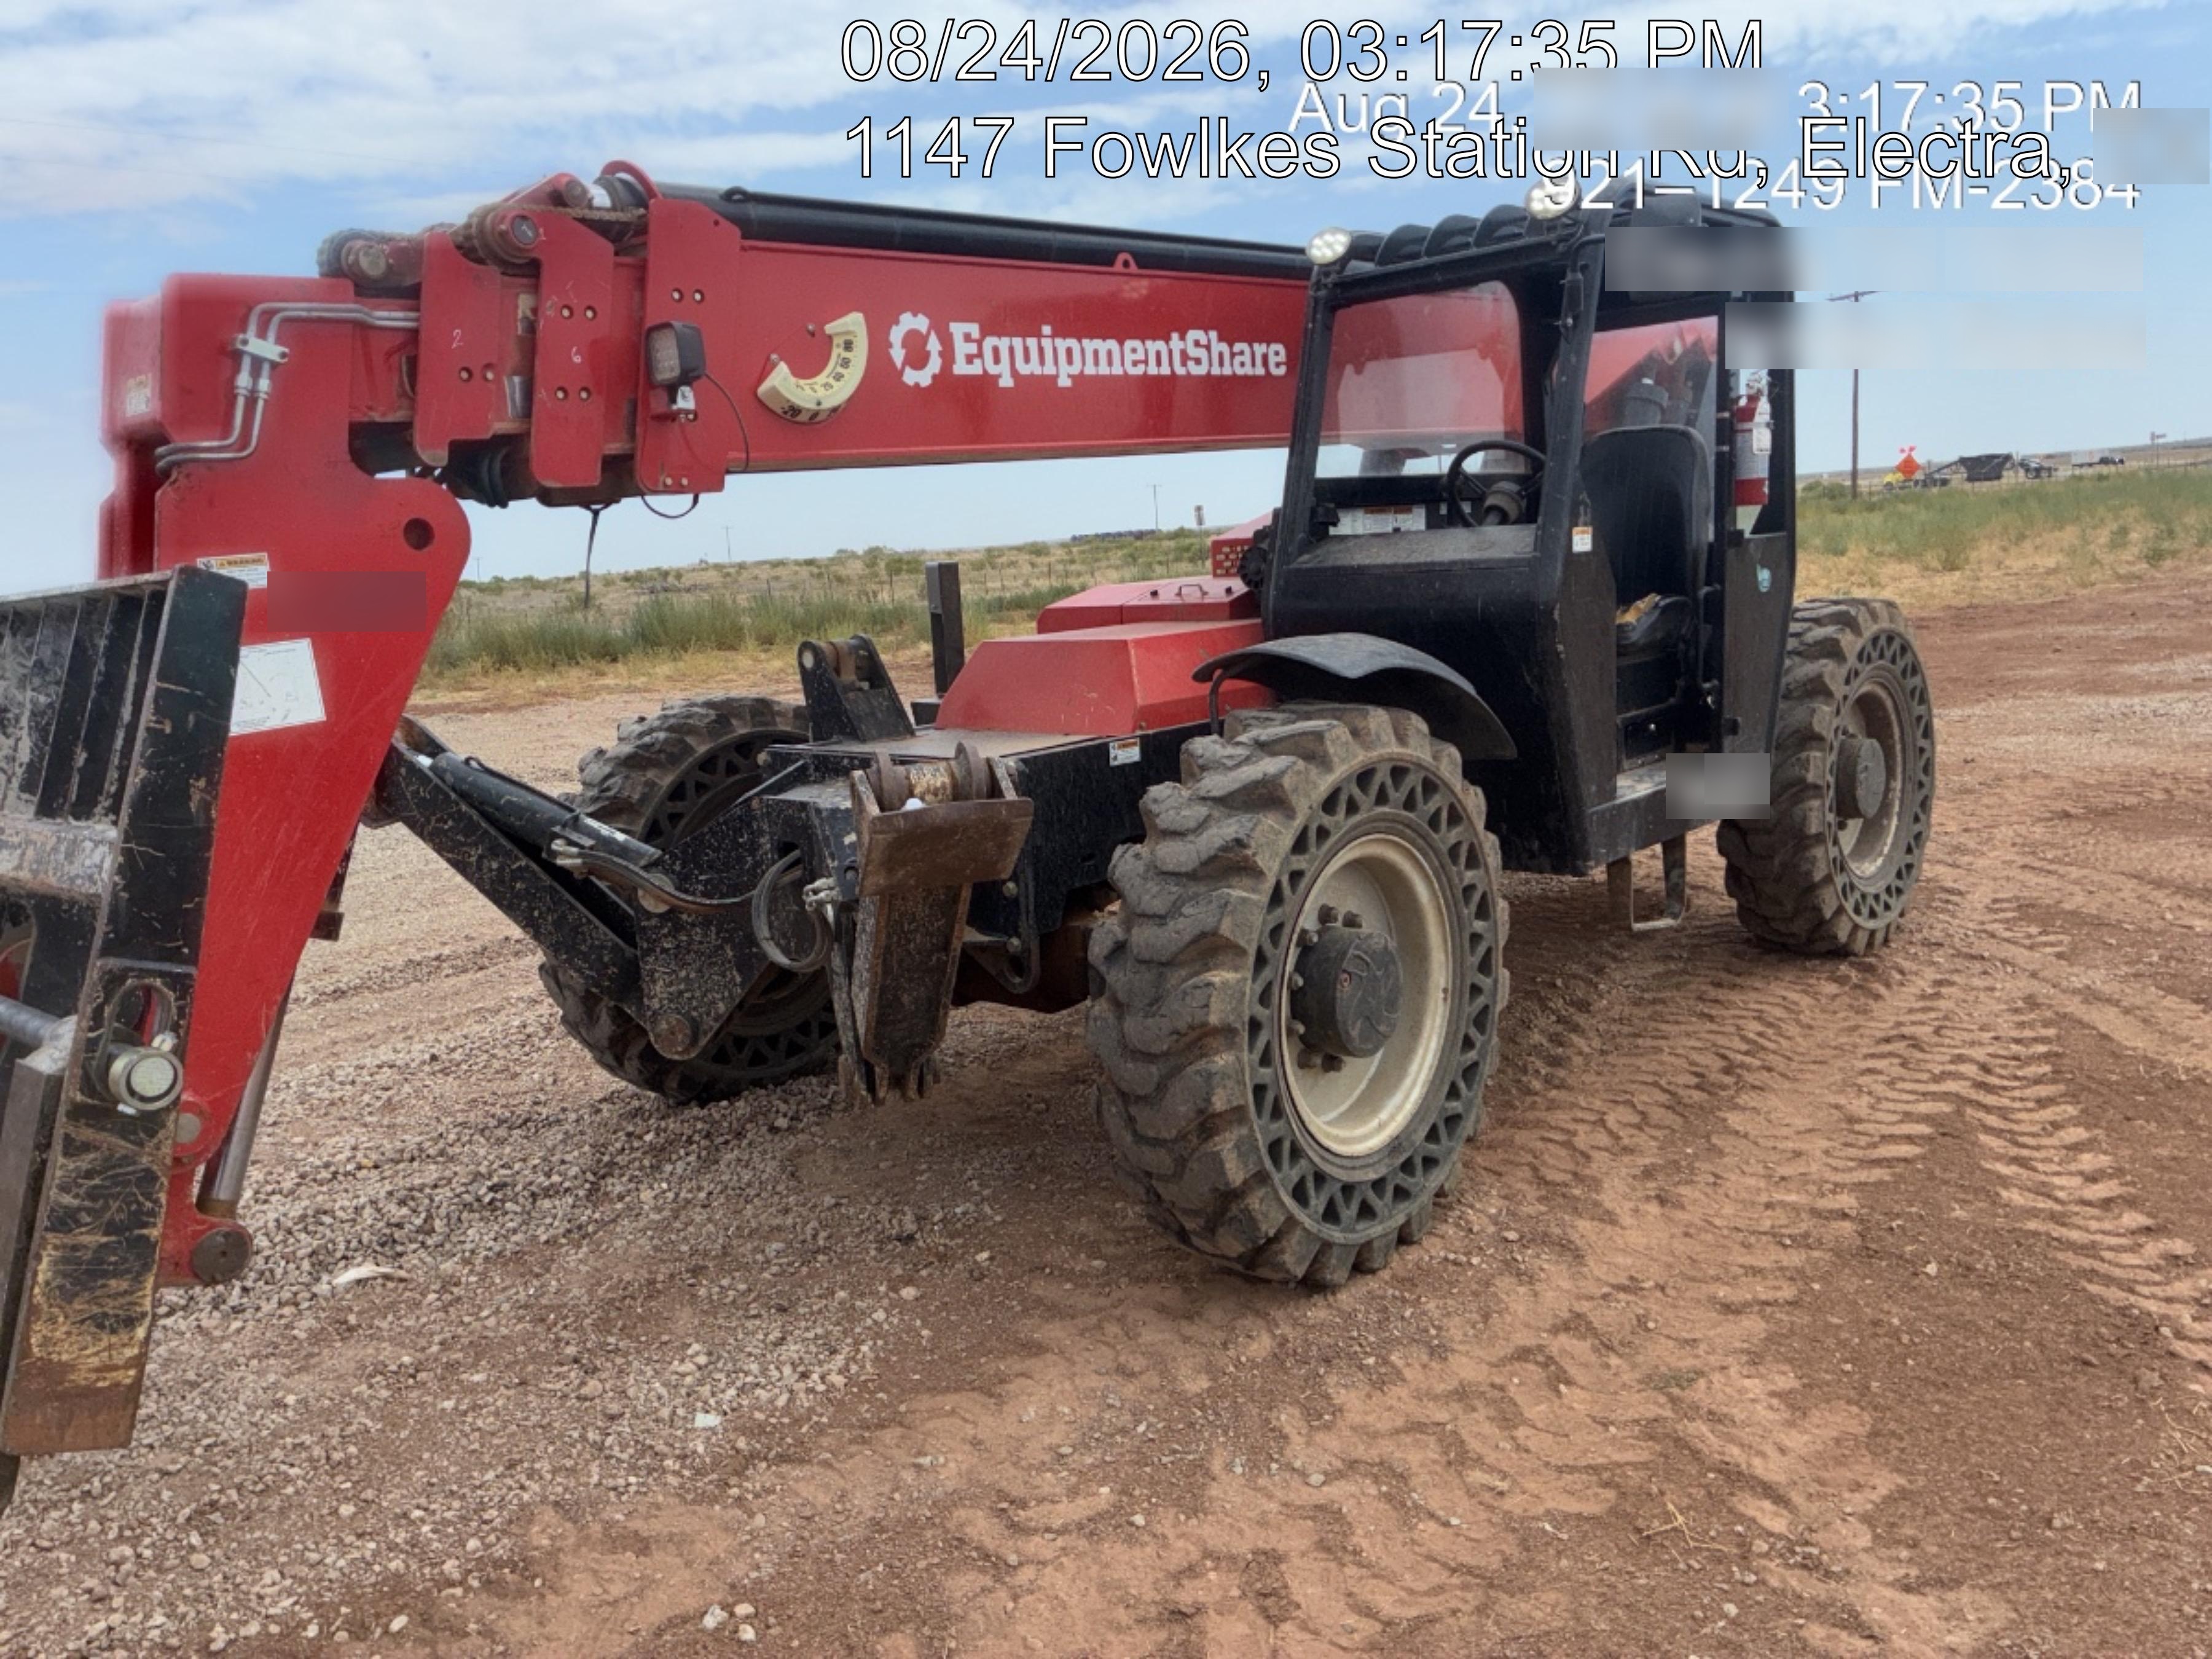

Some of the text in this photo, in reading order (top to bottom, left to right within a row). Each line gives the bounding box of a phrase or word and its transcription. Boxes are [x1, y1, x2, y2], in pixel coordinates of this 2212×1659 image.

[452, 329, 463, 349] 2
[571, 345, 582, 364] 6
[949, 322, 1288, 388] EquipmentShare
